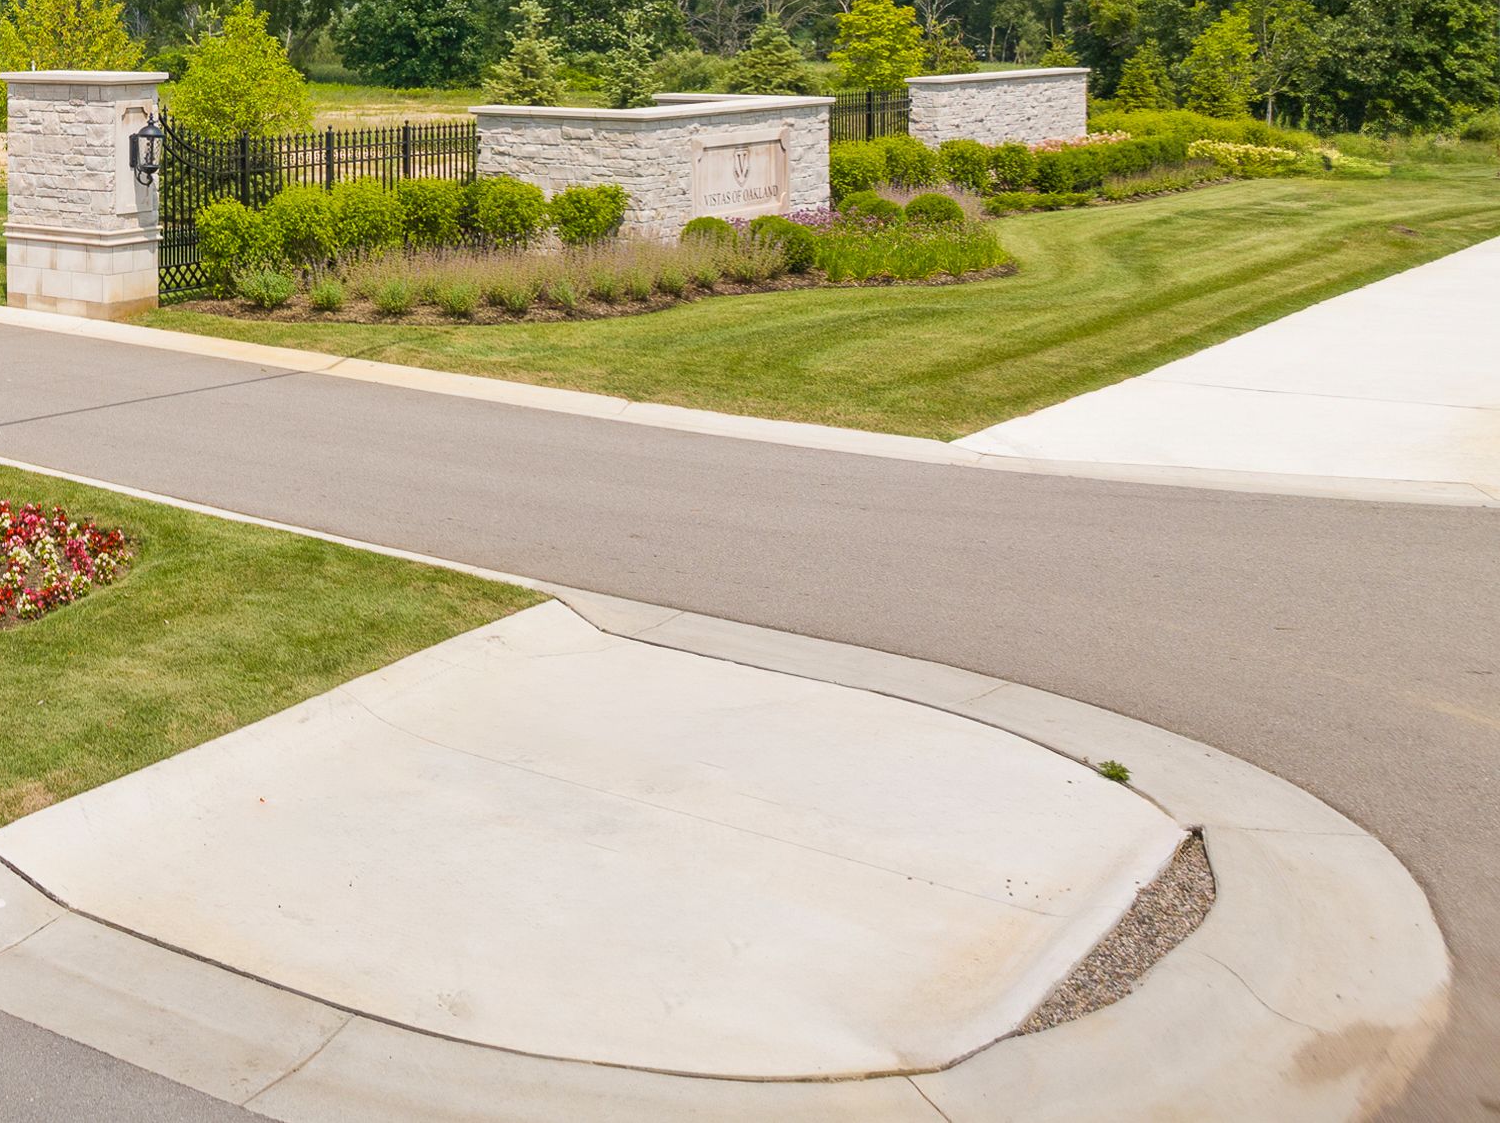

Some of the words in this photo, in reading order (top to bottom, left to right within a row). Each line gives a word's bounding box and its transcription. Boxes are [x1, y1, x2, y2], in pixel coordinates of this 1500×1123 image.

[703, 191, 731, 206] VISTAS
[731, 190, 742, 203] OF
[742, 185, 778, 201] OAKLAND
